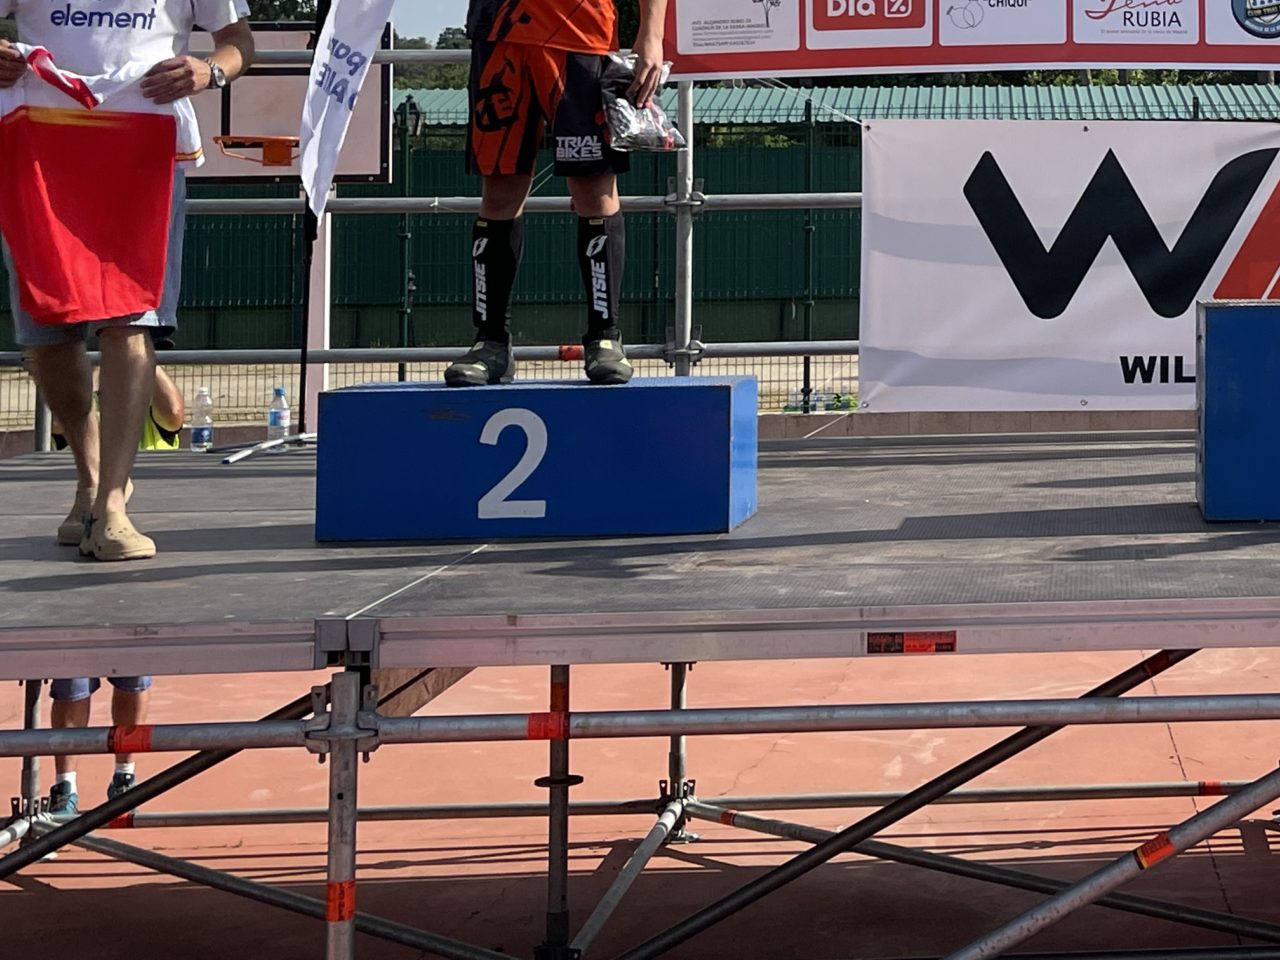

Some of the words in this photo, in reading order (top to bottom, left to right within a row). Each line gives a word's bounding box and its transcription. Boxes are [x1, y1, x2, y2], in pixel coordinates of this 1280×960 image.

[50, 3, 156, 30] element
[1123, 10, 1182, 27] RUBIA
[555, 136, 602, 147] TRIAL
[555, 146, 603, 158] BIKES
[474, 259, 487, 321] JITSIE
[591, 260, 609, 320] JITSIE
[477, 407, 549, 520] 2
